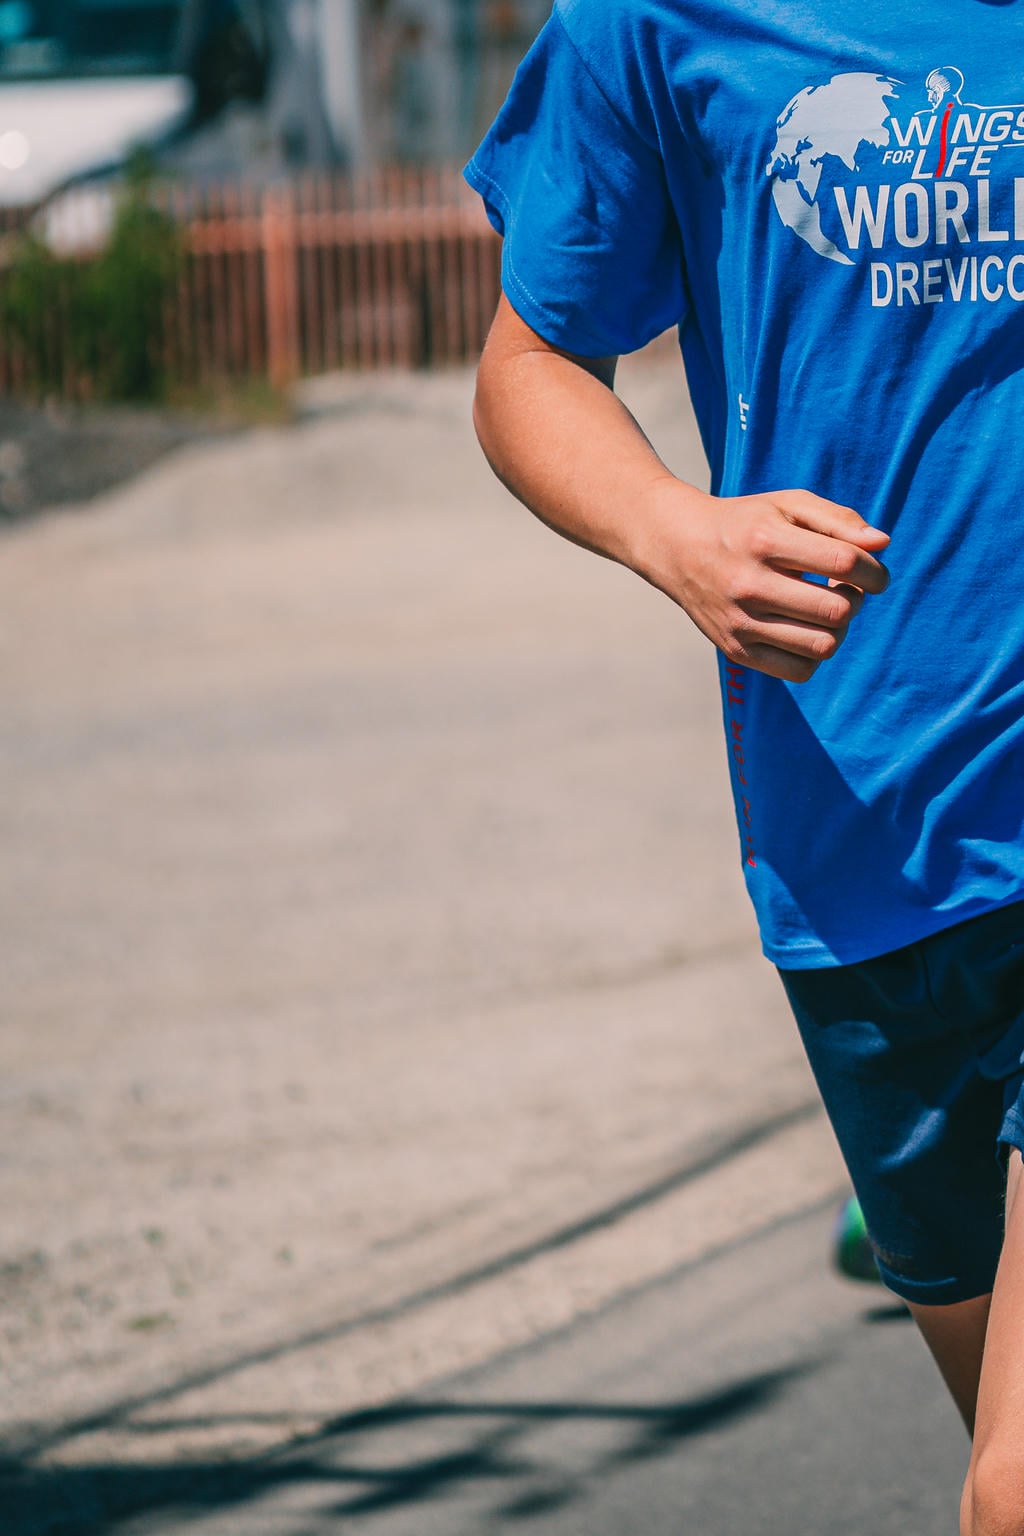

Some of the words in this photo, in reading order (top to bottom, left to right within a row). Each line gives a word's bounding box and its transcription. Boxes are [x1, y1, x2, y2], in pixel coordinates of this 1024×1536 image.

[882, 149, 912, 165] FOR
[911, 145, 998, 180] LIFE
[725, 656, 745, 707] TH
